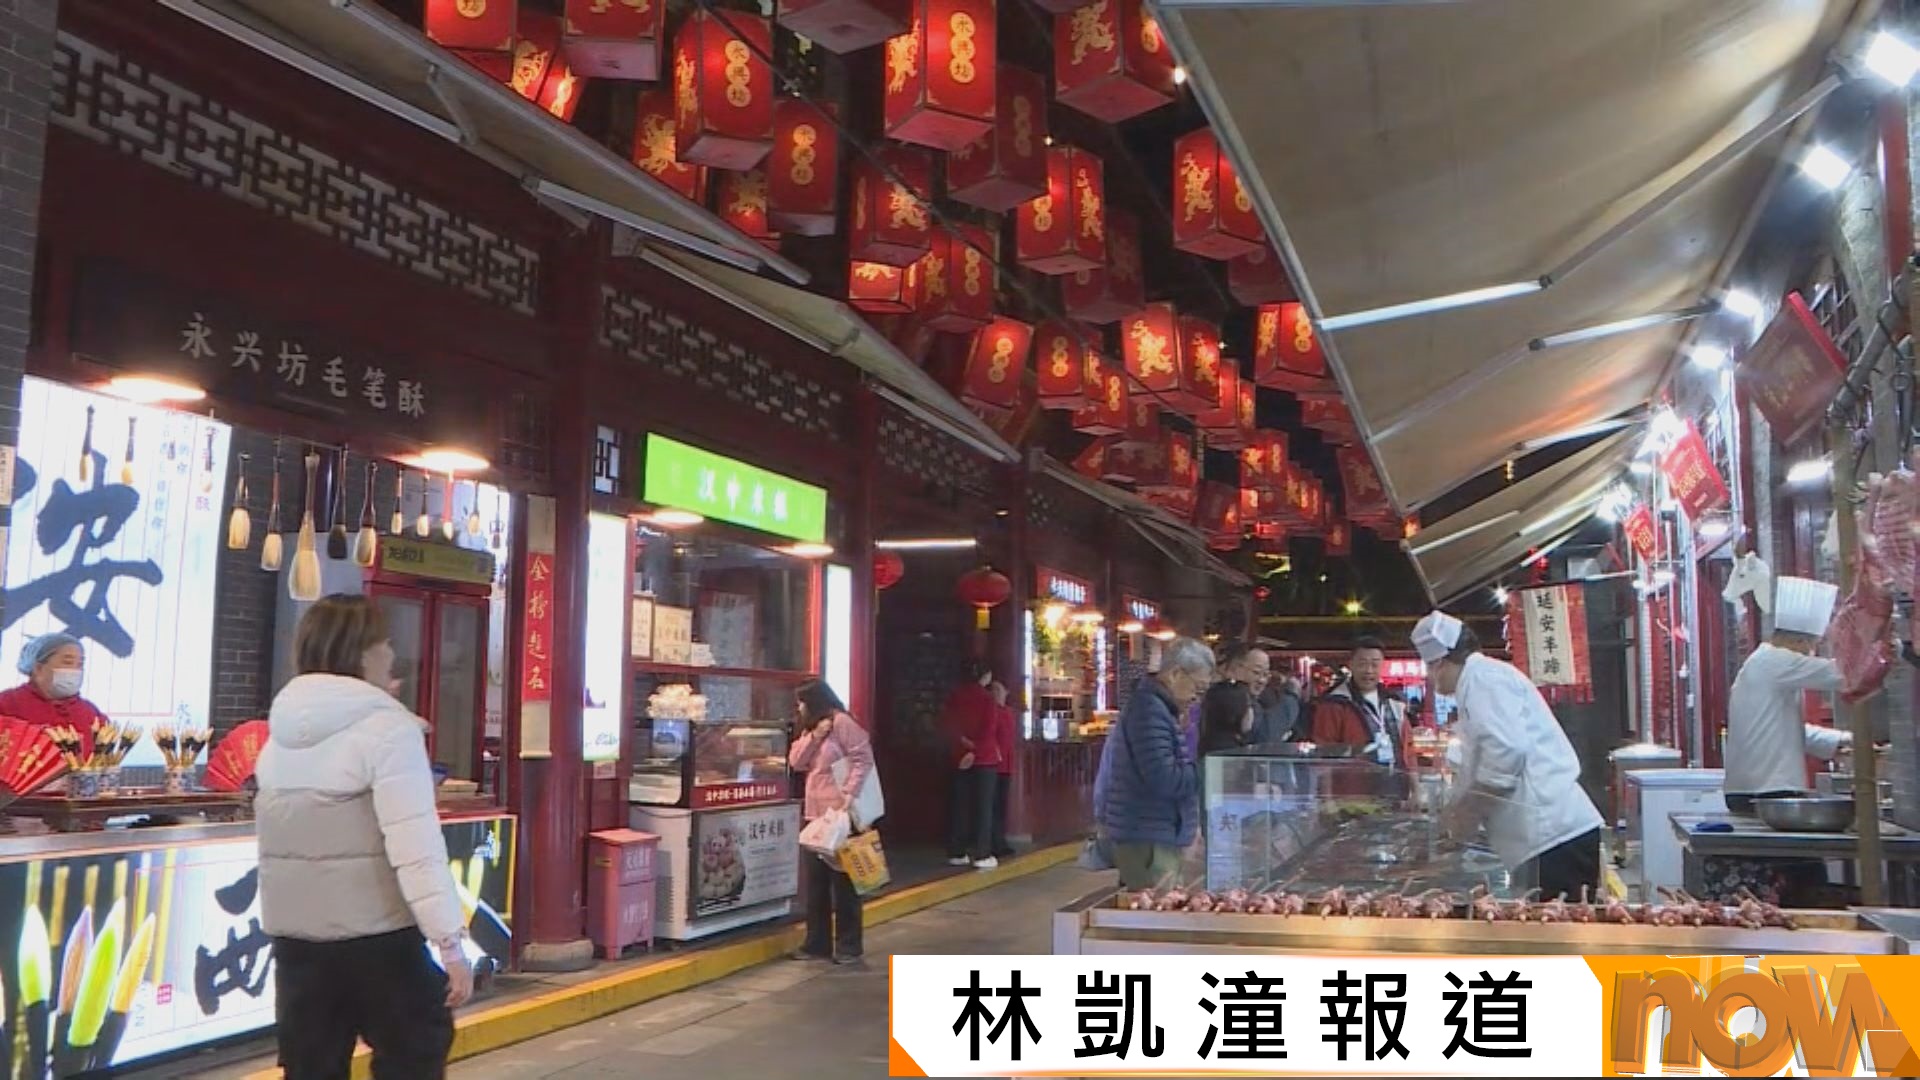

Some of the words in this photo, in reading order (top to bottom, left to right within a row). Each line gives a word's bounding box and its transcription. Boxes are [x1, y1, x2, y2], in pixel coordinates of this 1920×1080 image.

[179, 312, 426, 419] 永兴坊毛笔酥
